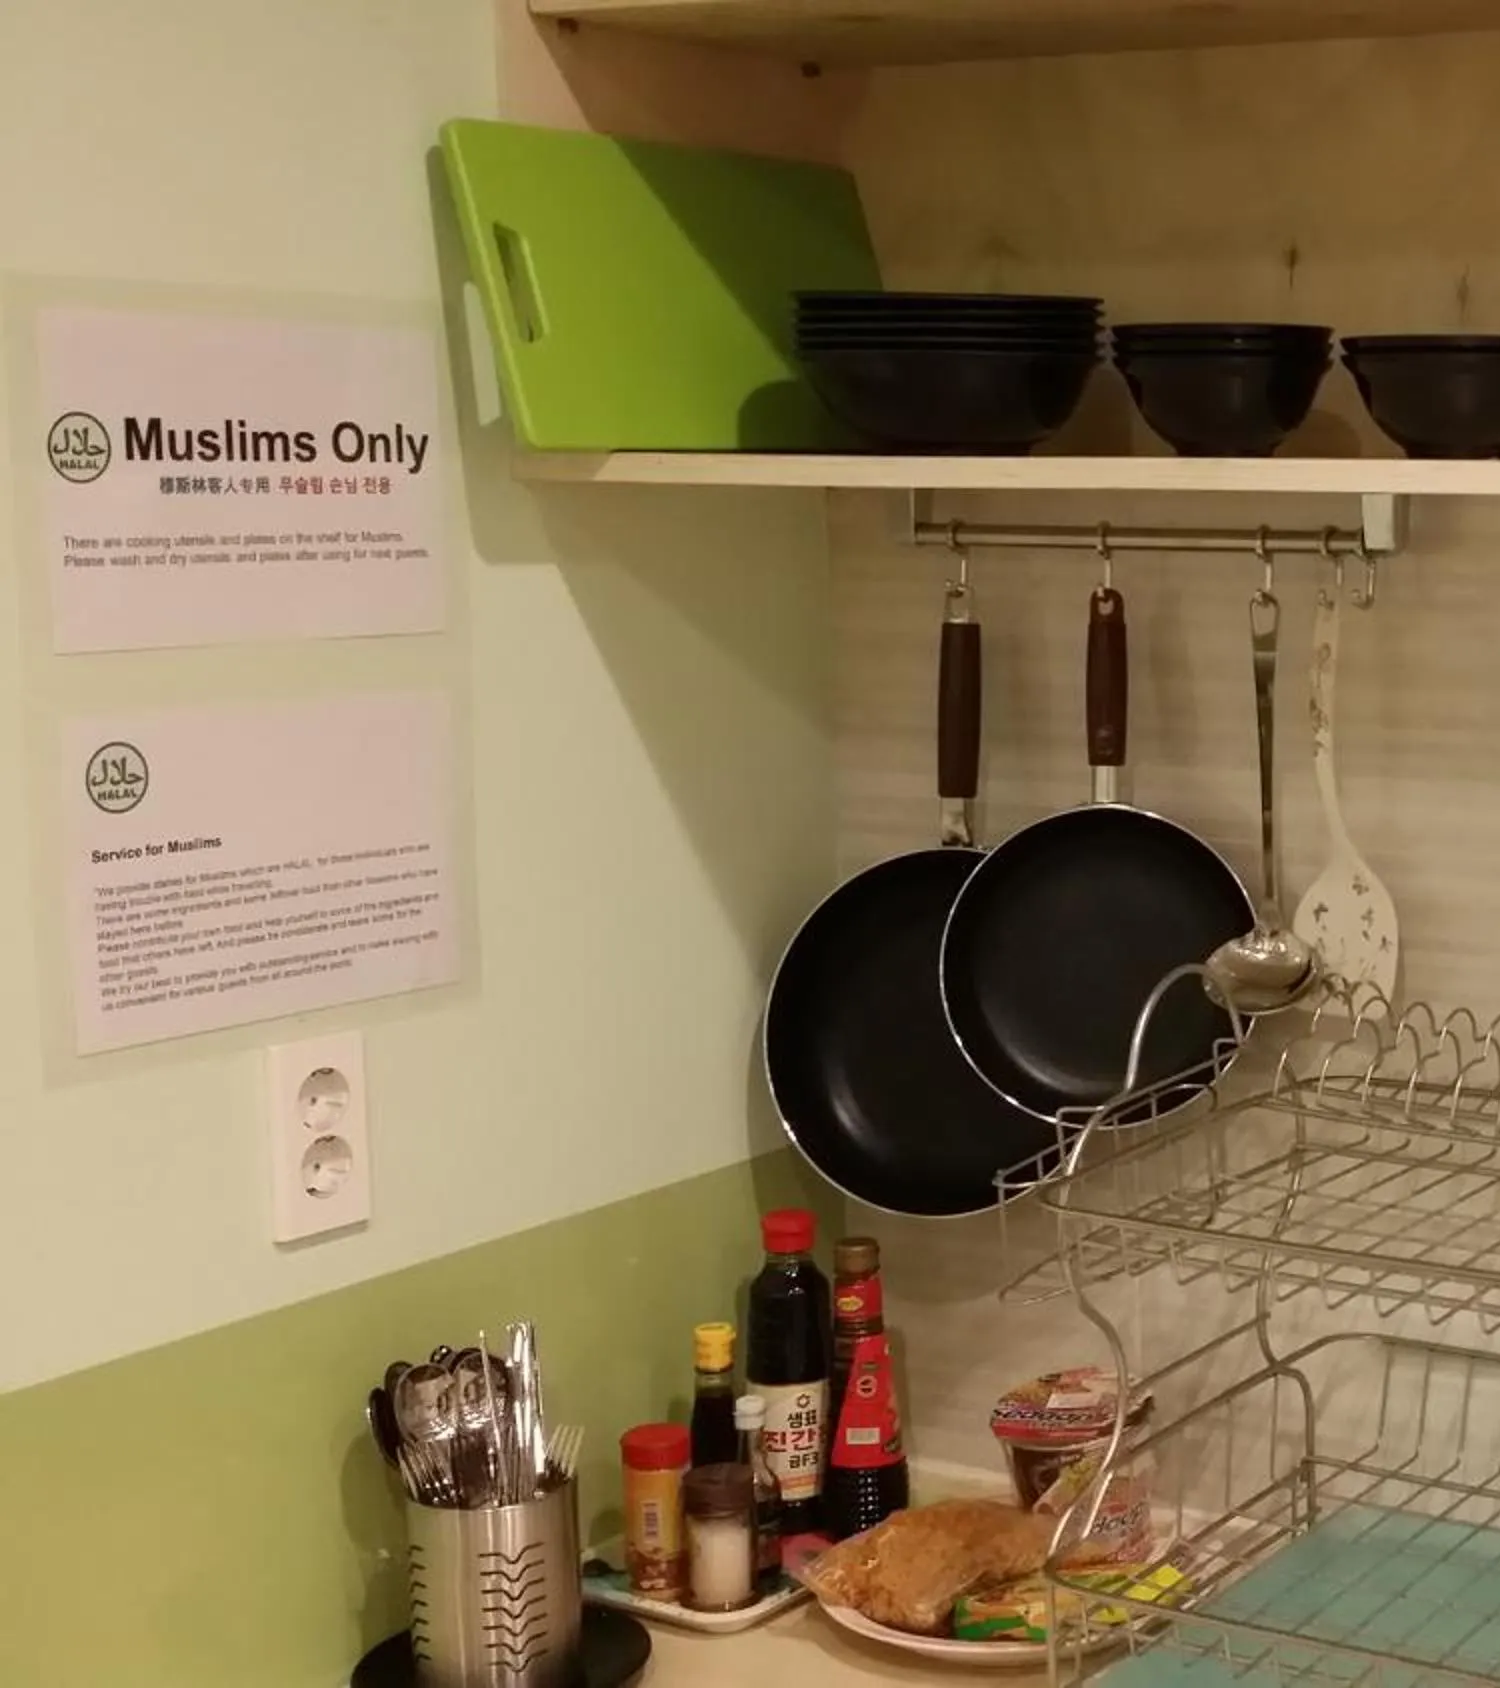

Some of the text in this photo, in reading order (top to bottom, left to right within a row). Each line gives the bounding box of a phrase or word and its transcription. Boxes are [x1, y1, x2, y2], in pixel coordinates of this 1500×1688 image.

[124, 417, 429, 474] Muslims Only
[59, 458, 100, 469] HALAL
[279, 476, 392, 495] 무슬림 손님 전용
[98, 788, 136, 800] HALAL
[92, 837, 222, 863] Service for Muslims
[787, 1409, 817, 1429] 샘표
[763, 1429, 826, 1452] 진간
